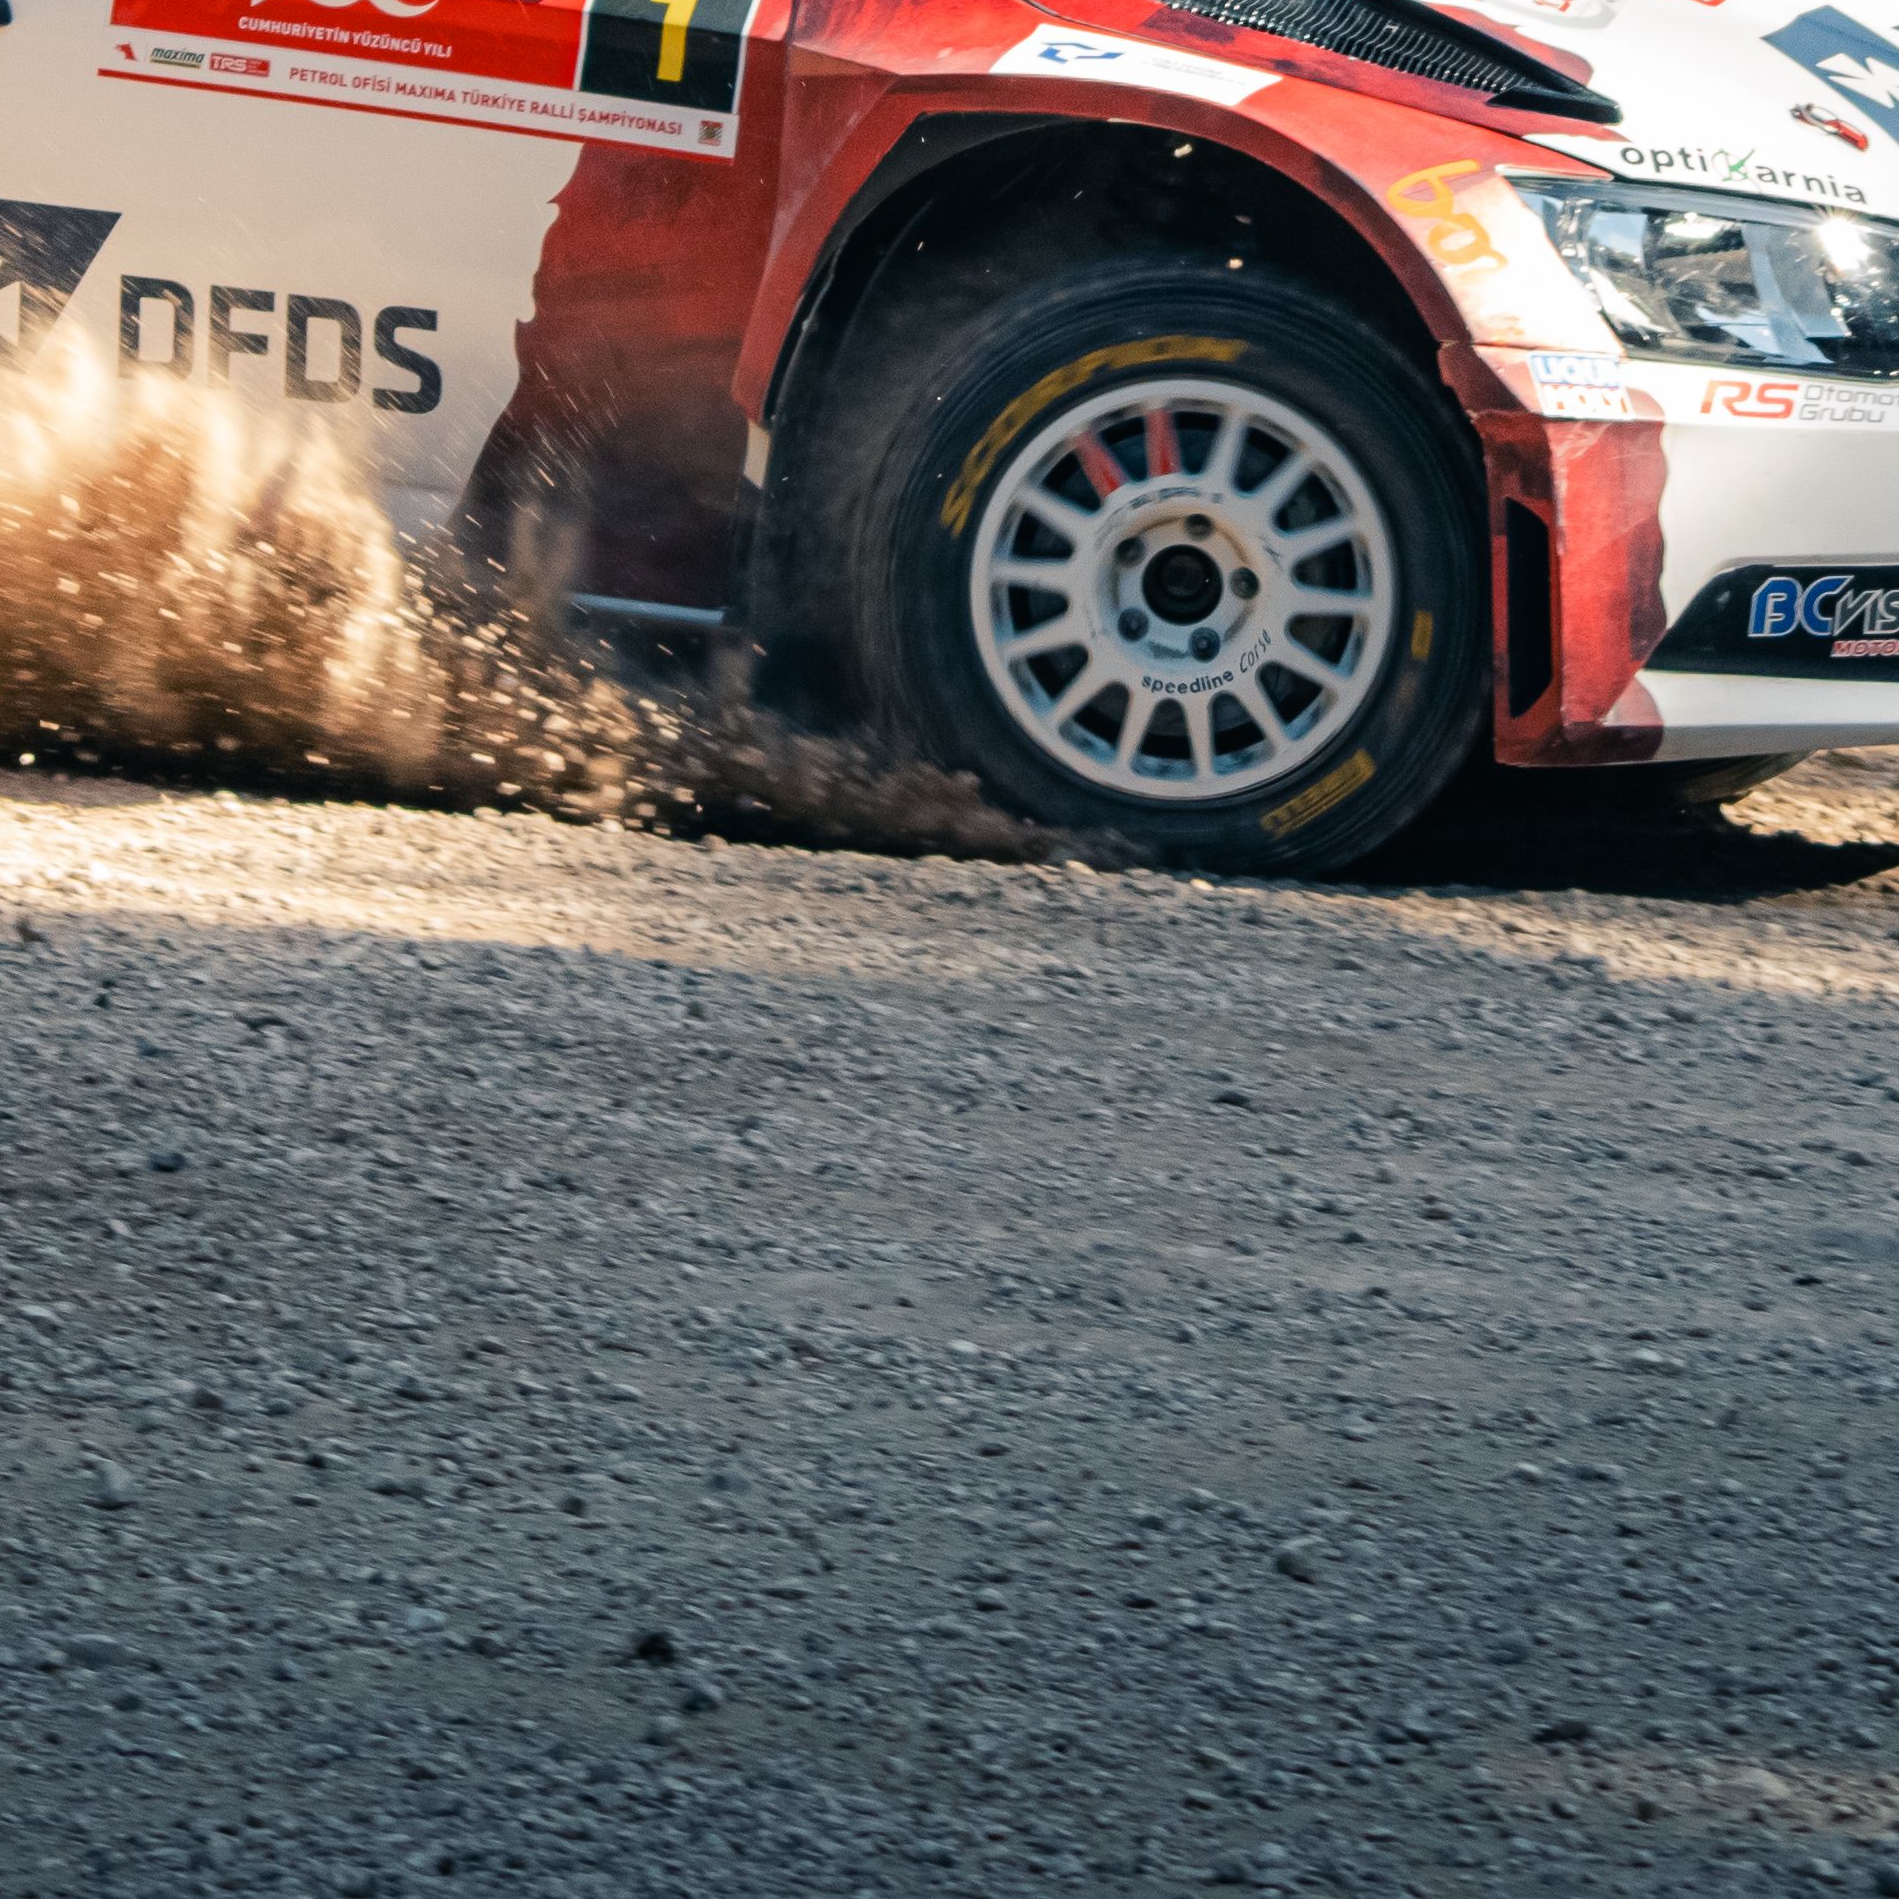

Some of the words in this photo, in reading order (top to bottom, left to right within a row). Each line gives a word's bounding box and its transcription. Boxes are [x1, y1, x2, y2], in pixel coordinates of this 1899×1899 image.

[151, 46, 205, 64] maxima
[289, 67, 347, 87] PETROL
[396, 84, 456, 103] MAXIMA
[119, 275, 443, 415] DFDS
[1699, 379, 1800, 419] RS
[1799, 401, 1886, 424] Grubu
[1239, 628, 1272, 674] Corse
[1141, 670, 1235, 694] speedline
